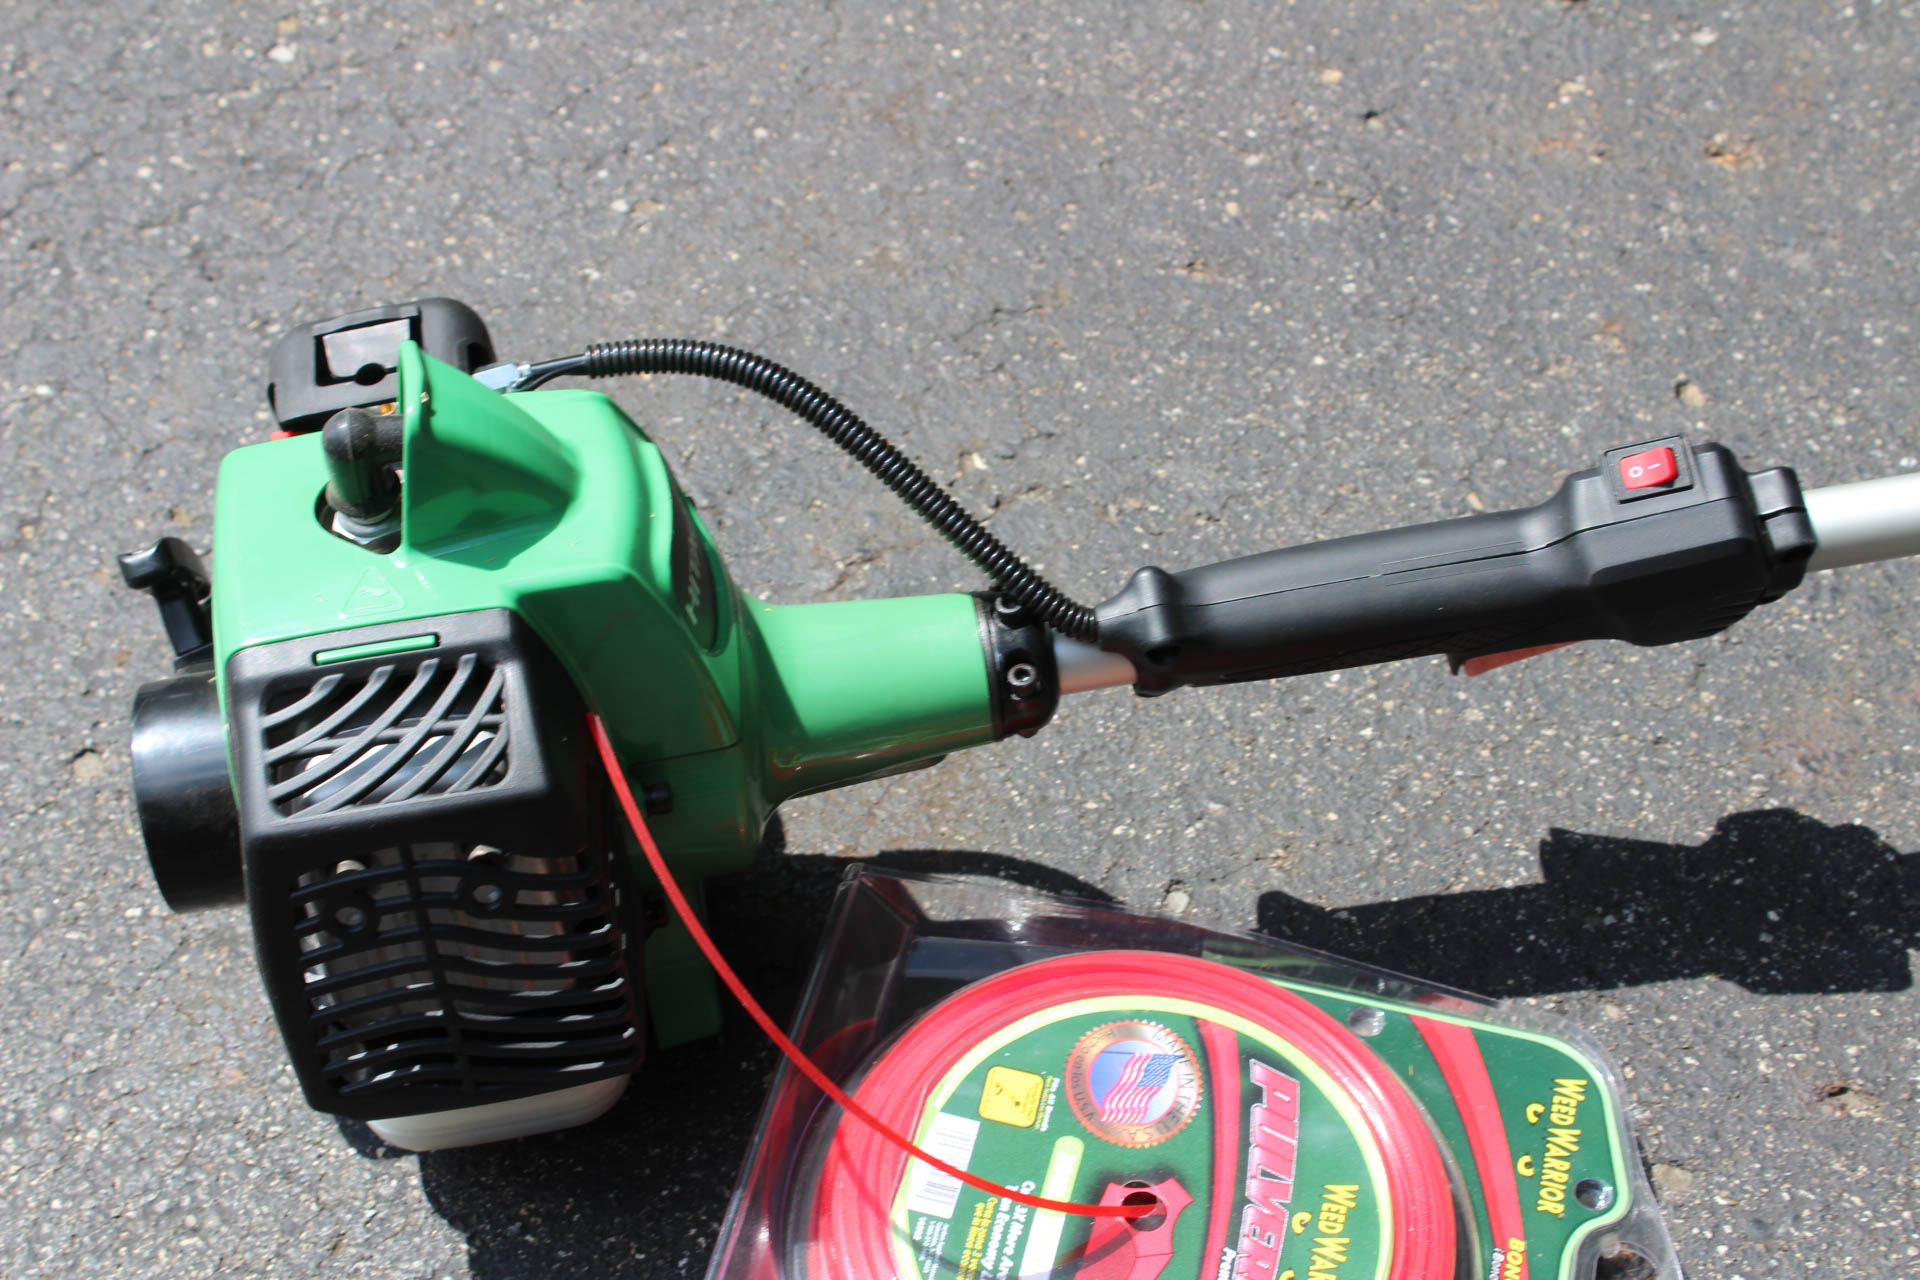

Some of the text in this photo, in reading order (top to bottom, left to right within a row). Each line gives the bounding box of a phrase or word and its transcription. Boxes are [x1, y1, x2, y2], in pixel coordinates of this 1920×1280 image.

[1231, 1058, 1300, 1280] PULVER
[1536, 1078, 1588, 1215] WEED WARRIOR
[999, 1184, 1020, 1212] Tan
[1317, 1184, 1361, 1235] WEED
[981, 1211, 1011, 1271] Economy
[1004, 1221, 1024, 1256] More
[1503, 1236, 1526, 1280] BON
